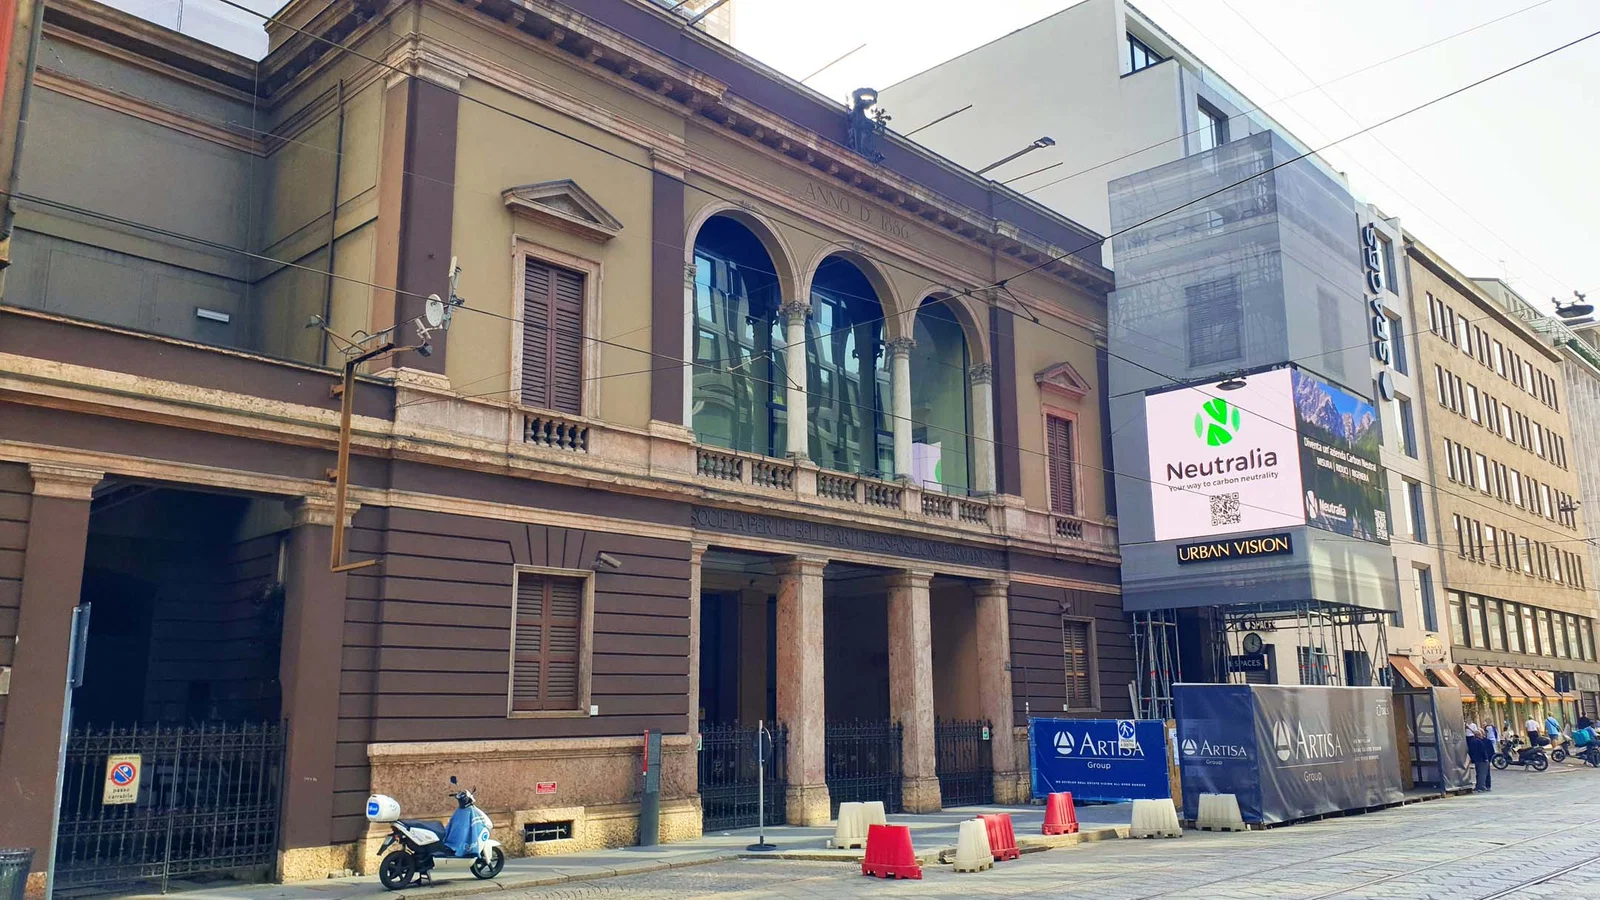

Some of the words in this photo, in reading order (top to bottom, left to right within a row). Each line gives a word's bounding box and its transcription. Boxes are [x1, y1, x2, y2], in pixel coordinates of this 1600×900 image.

[805, 181, 850, 214] ANNO
[880, 215, 909, 239] 1886
[1166, 448, 1278, 482] Neutralia
[1303, 436, 1322, 452] Diventa
[1347, 453, 1362, 466] Carbon
[1362, 459, 1377, 472] Neutral
[1168, 484, 1186, 492] Your
[1212, 477, 1240, 486] carbon
[1240, 472, 1279, 483] neutrality
[1318, 498, 1347, 517] Neutralia
[748, 515, 773, 535] PER
[775, 521, 791, 538] LE
[795, 522, 832, 543] BELLE
[1178, 543, 1230, 562] URBAN
[1233, 537, 1289, 556] VISION
[1200, 739, 1247, 757] ARTISA
[1296, 720, 1344, 760] ARTISA
[1087, 761, 1111, 770] Group
[1304, 771, 1323, 782] Group
